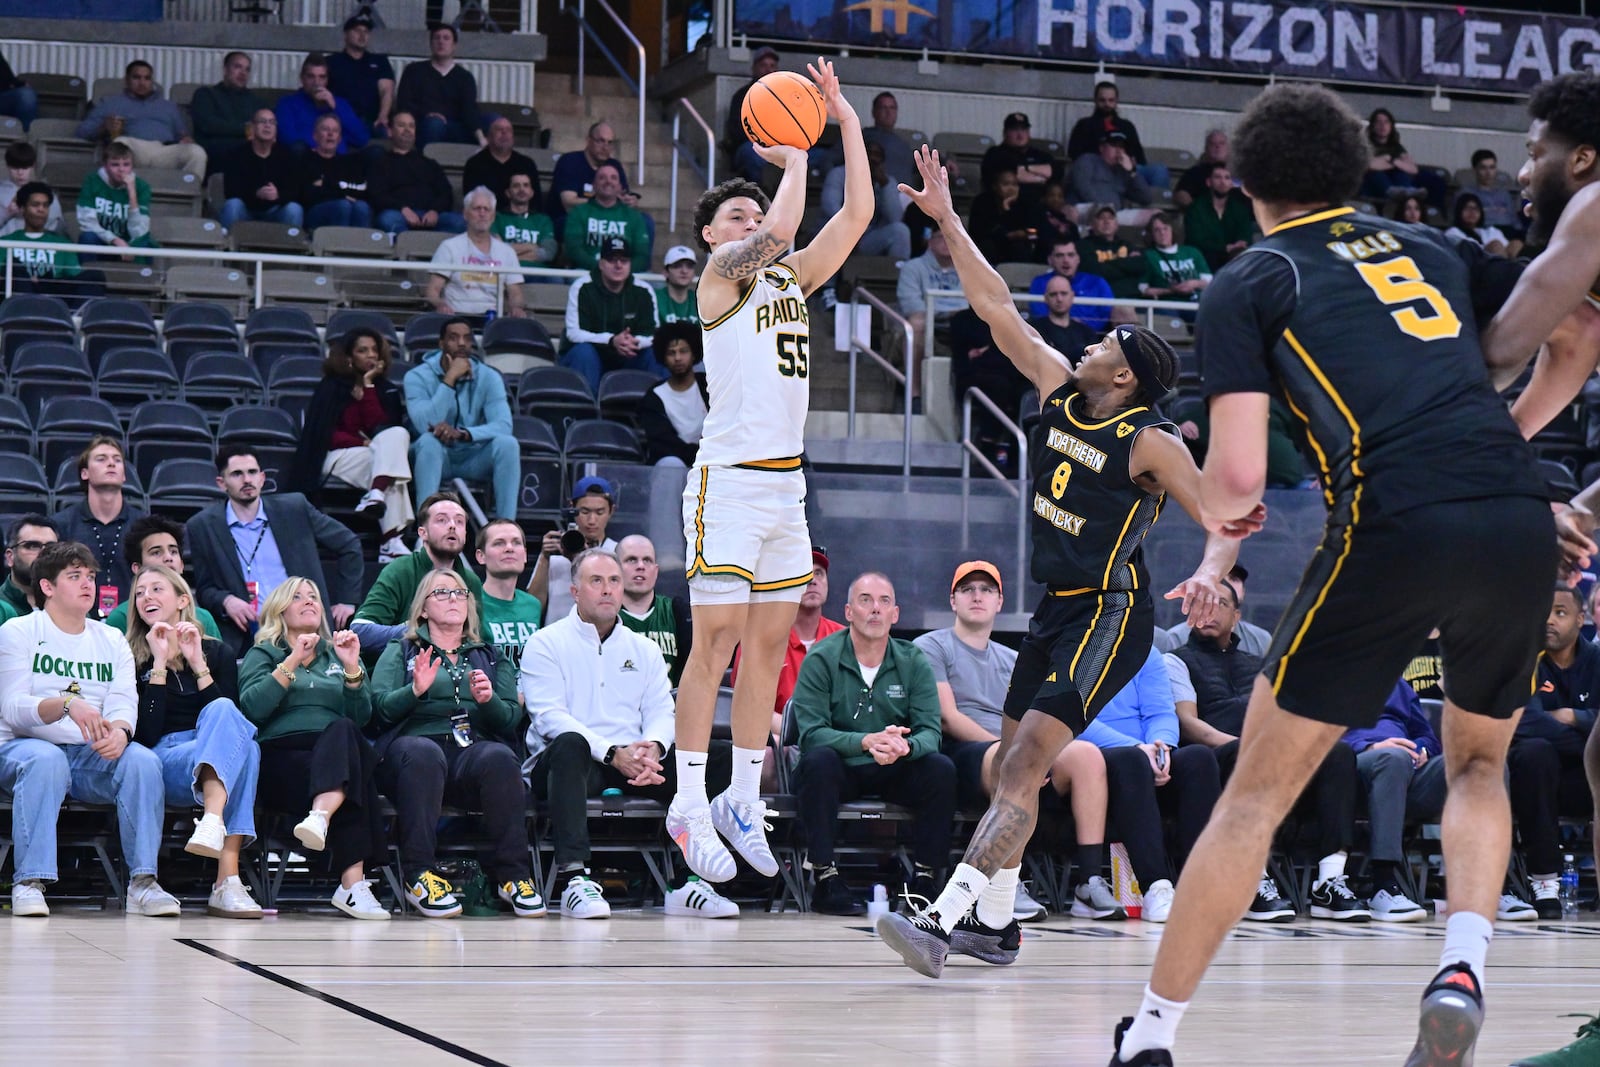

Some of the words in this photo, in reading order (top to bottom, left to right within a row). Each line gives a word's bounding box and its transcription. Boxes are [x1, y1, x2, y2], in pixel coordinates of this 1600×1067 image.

[1037, 0, 1379, 71] HORIZON
[505, 224, 540, 244] BEAT
[588, 216, 627, 235] BEAT
[1326, 230, 1403, 260] WELLS
[1353, 256, 1462, 342] 5
[776, 332, 808, 378] 55
[1046, 426, 1108, 474] NORTHERN
[1051, 461, 1072, 500] 8
[32, 652, 75, 678] LOCK
[77, 662, 93, 681] IT
[96, 662, 114, 683] IN
